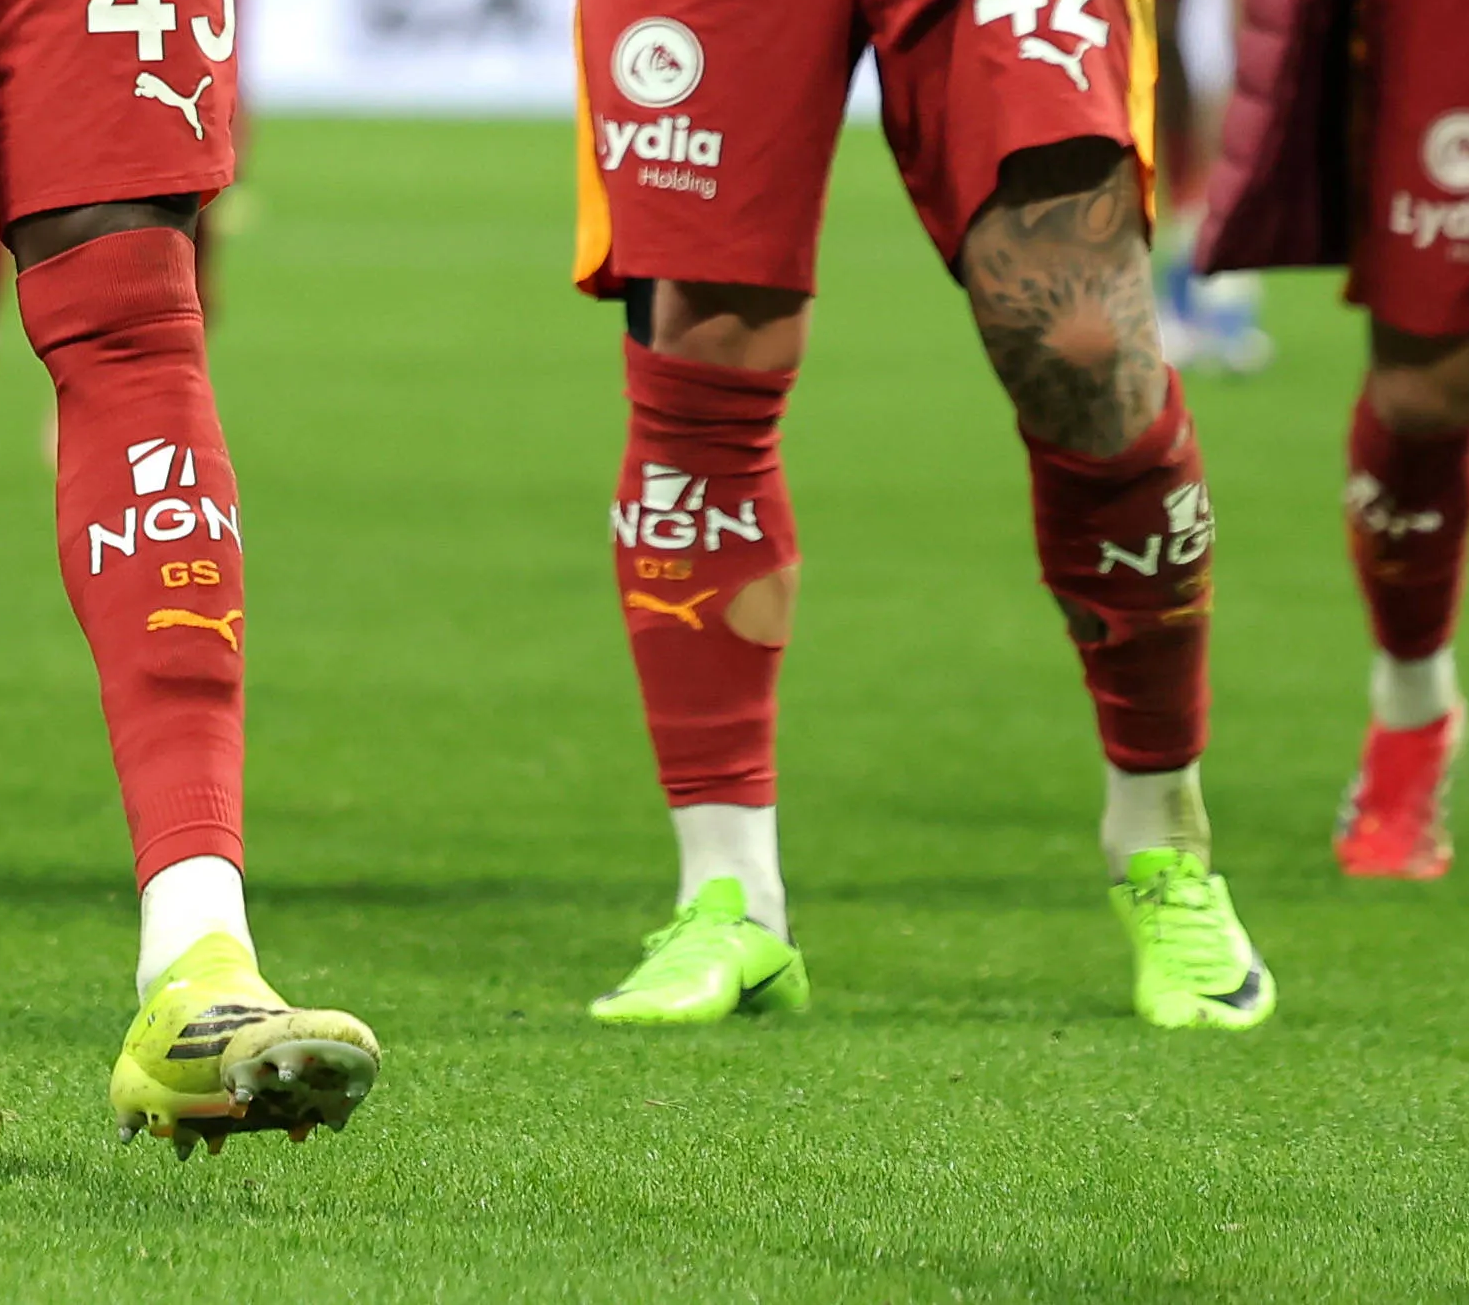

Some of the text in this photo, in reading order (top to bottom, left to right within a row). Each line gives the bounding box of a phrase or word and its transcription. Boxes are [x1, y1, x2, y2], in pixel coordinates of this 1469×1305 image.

[89, 496, 243, 575] NGN
[609, 499, 764, 553] NGN
[162, 560, 221, 588] GS
